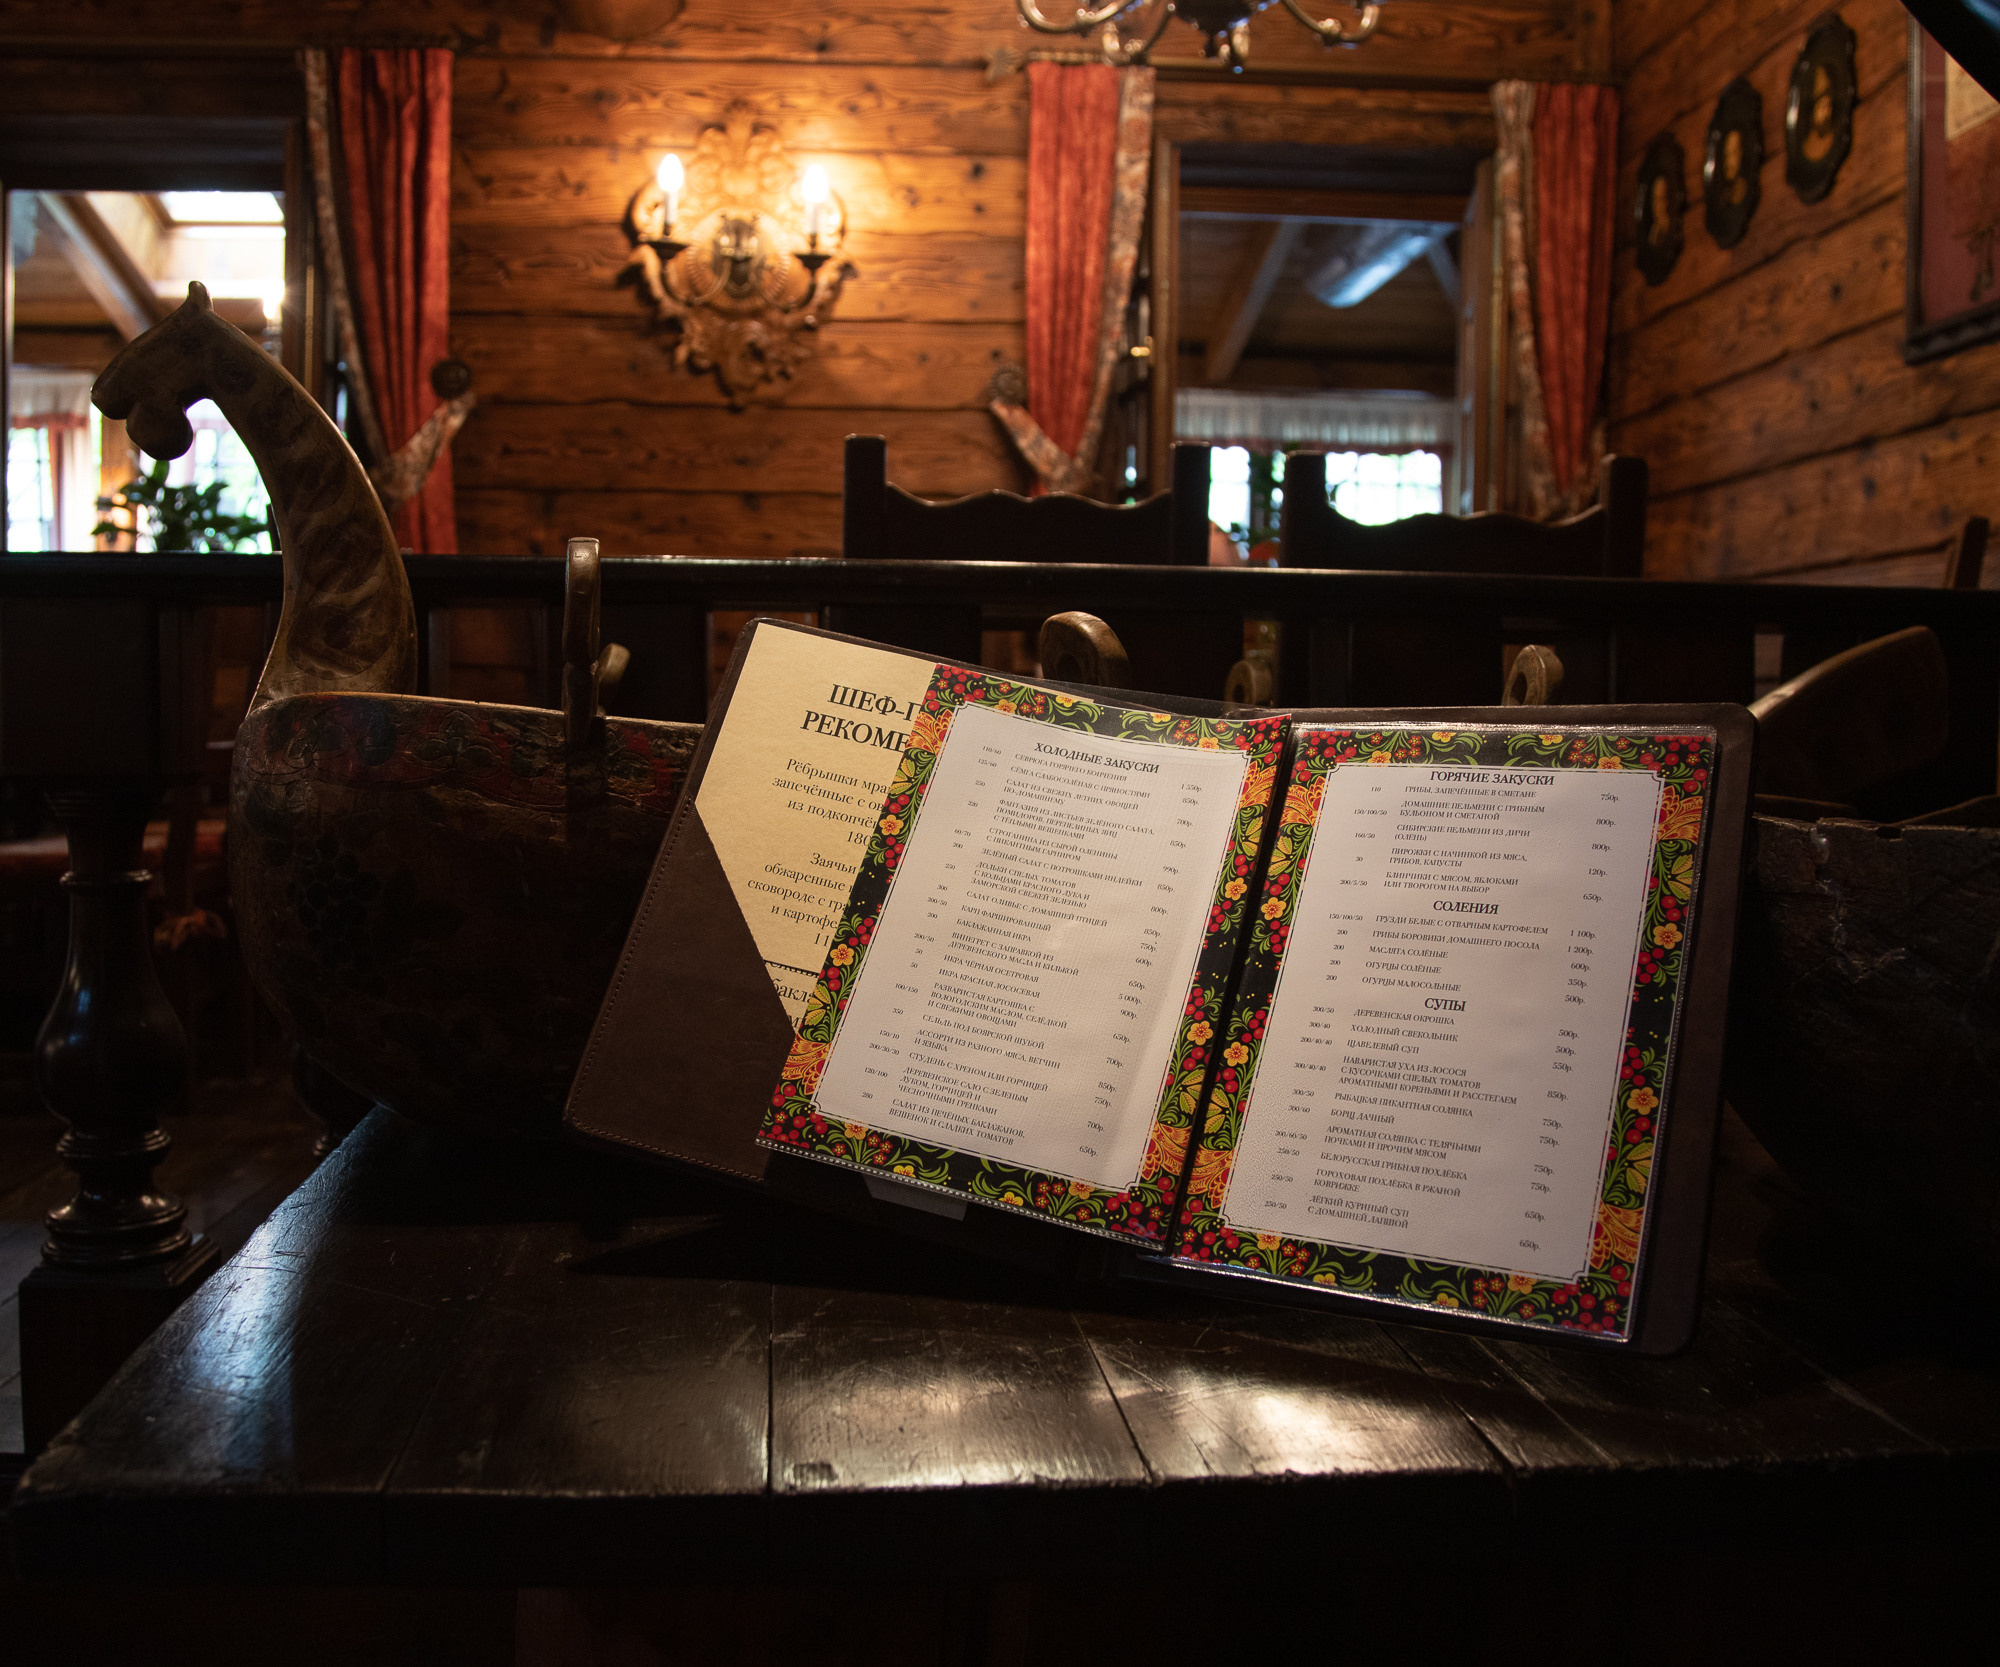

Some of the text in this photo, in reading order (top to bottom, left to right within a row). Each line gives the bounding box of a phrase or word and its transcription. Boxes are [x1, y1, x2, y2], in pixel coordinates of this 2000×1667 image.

[1034, 743, 1159, 773] ХОЛОДНЫЕ ЗАКУСКИ
[786, 758, 890, 796] Рёбрышки мра
[1430, 771, 1554, 785] ГОРЯЧИЕ ЗАКУСКИ
[772, 777, 854, 804] запечённые
[858, 798, 866, 808] с
[1601, 793, 1618, 802] 750р.
[787, 799, 803, 811] из
[1400, 809, 1444, 817] БУЛЬОНОМ
[1454, 812, 1499, 820] СМЕТАНОЙ
[1595, 818, 1616, 827] 800р.
[1394, 833, 1427, 841] (ОЛЕНЬ)
[1591, 843, 1611, 852] 800р.
[1391, 848, 1431, 856] ПИРОЖКИ
[1440, 850, 1487, 859] НАЧИНКОЙ
[1503, 853, 1527, 861] МЯСА,
[809, 852, 857, 875] Заячьи
[1389, 857, 1462, 867] ГРИБОВ, КАПУСТЫ
[764, 862, 846, 892] обжаренные
[1588, 868, 1607, 877] 120р.
[747, 879, 816, 905] сковороде
[818, 897, 826, 907] с
[1404, 882, 1446, 890] ТВОРОГОМ
[1461, 885, 1490, 893] ВЫБОР
[1582, 893, 1601, 902] 650р.
[1433, 900, 1498, 914] СОЛЕНИЯ
[771, 904, 838, 931] и картофе
[1375, 915, 1406, 924] ГРУЗДИ
[1408, 917, 1435, 925] БЕЛЫЕ
[1444, 920, 1491, 929] ОТВАРНЫМ
[1492, 923, 1548, 934] КАРТОФЕЛЕМ
[1372, 930, 1539, 949] ГРИБЫ БОРОВИКИ ДОМАШНЕГО ПОСОЛА
[1577, 930, 1596, 940] 100р.
[1369, 946, 1405, 955] МАСЛЯТА
[1573, 946, 1593, 956] 200р.
[1365, 961, 1399, 971] ОГУРЦЫ
[1570, 962, 1591, 972] 600р.
[1362, 977, 1461, 991] ОГУРЦЫ МАЛОСОЛЬНЫЕ
[1567, 978, 1588, 988] 350р.
[1424, 997, 1466, 1011] СУПЫ
[1564, 994, 1585, 1005] 500р.
[1353, 1009, 1454, 1025] ДЕРЕВЕНСКАЯ ОКРОШКА
[1350, 1024, 1458, 1041] ХОЛОДНЫЙ СВЕКОЛЬНИК
[1558, 1029, 1577, 1039] 500р.
[1347, 1039, 1419, 1054] ЩАВЕЛЕВЫЙ СУП
[1555, 1045, 1576, 1056] 500р.
[1552, 1061, 1573, 1072] 550р.
[1348, 1067, 1400, 1079] КУСОЧКАМИ
[1402, 1073, 1437, 1084] СПЕЛЫХ
[1440, 1077, 1480, 1089] ТОМАТОВ
[1338, 1077, 1397, 1090] АРОМАТНЫМИ
[1399, 1084, 1450, 1096] КОРЕНЬЯМИ
[1462, 1091, 1517, 1104] РАССТЕГАЕМ
[1547, 1090, 1568, 1101] 850р.
[1330, 1108, 1394, 1123] БОРЩ ДАЧНЫЙ
[1543, 1118, 1563, 1129] 750р.
[1539, 1136, 1559, 1147] 750р.
[1534, 1164, 1554, 1176] 750р.
[1314, 1179, 1360, 1192] КОВРИЖКЕ
[1531, 1182, 1551, 1193] 750р.
[1524, 1211, 1544, 1222] 650р.
[1519, 1239, 1540, 1251] 650р.
